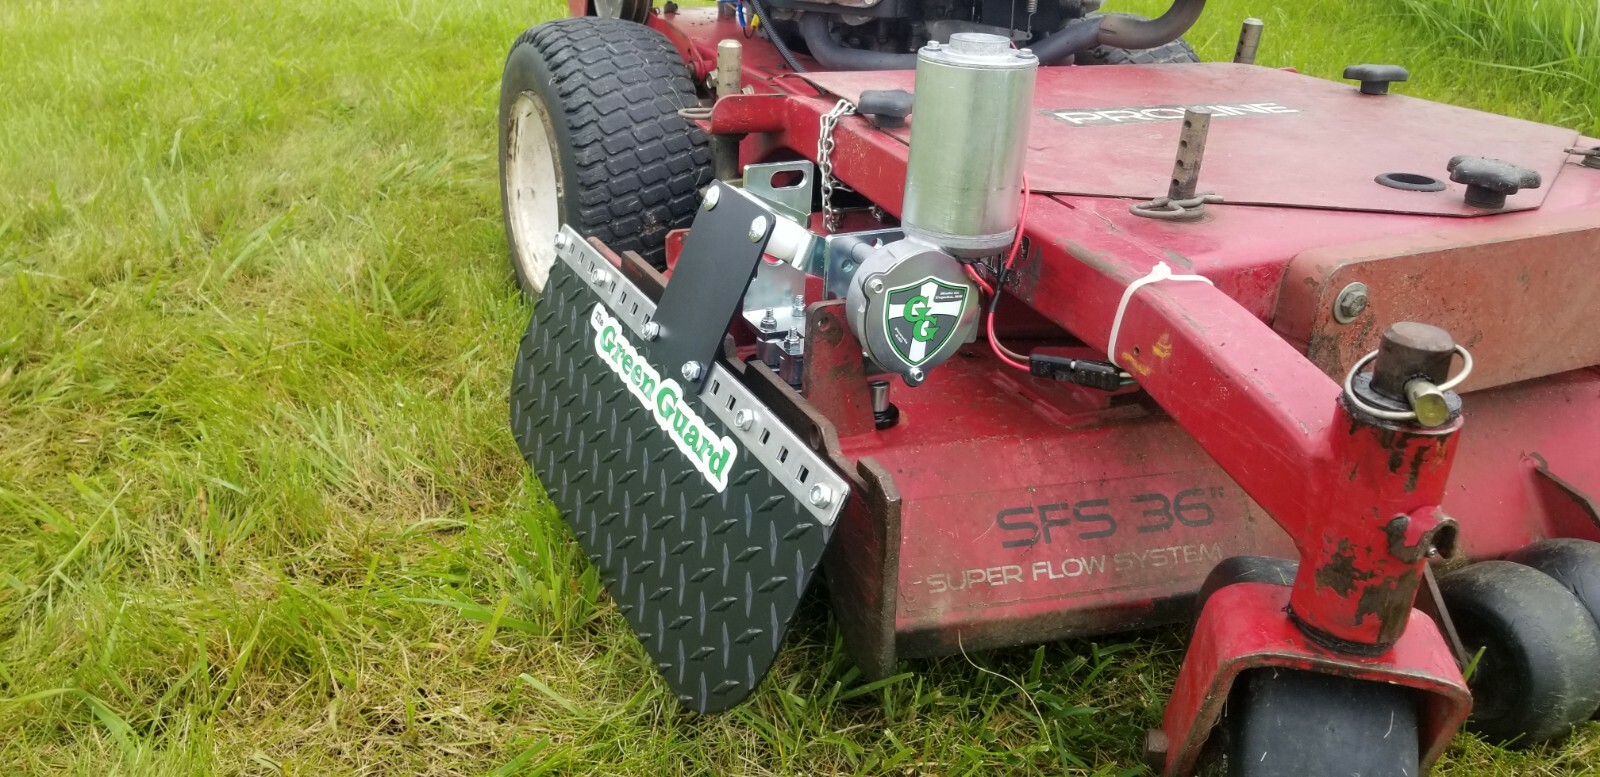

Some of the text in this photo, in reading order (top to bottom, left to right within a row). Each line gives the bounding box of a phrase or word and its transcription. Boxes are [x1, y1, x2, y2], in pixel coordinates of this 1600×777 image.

[601, 325, 657, 402] Green
[656, 386, 731, 483] Guard
[996, 499, 1117, 548] SFS
[926, 542, 1223, 594] SUPER FLOW SYSTEM
